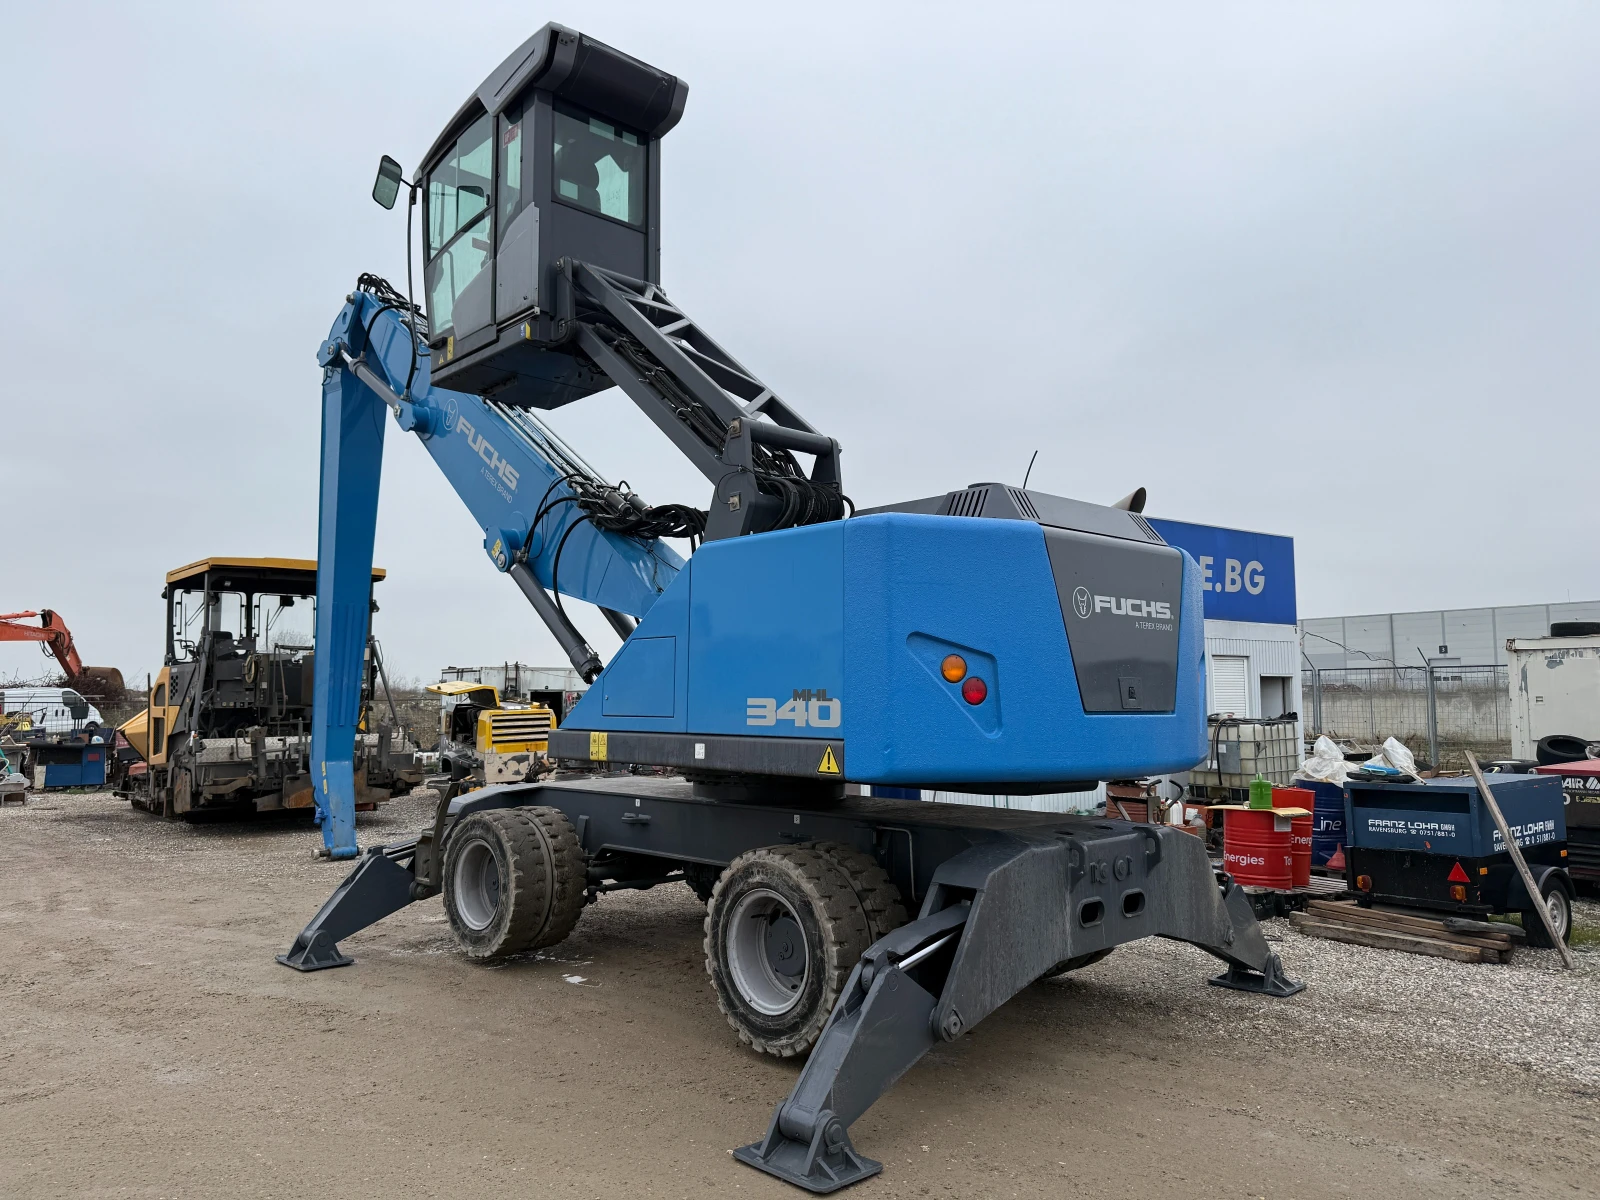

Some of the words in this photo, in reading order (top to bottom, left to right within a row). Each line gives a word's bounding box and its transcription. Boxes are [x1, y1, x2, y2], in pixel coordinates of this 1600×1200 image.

[455, 415, 520, 491] FUCHS
[484, 470, 498, 489] TEREX
[496, 484, 513, 504] BRAND
[1093, 594, 1172, 620] FUCHS
[1135, 621, 1140, 630] A
[1140, 621, 1156, 631] TEREX
[1156, 622, 1173, 632] BRAND
[792, 688, 834, 702] MHL
[746, 697, 842, 728] 340
[1368, 818, 1406, 829] FRANZ
[1407, 821, 1439, 832] LOHR
[1368, 826, 1408, 836] RAVENSBURG
[1522, 821, 1545, 836] LOHR
